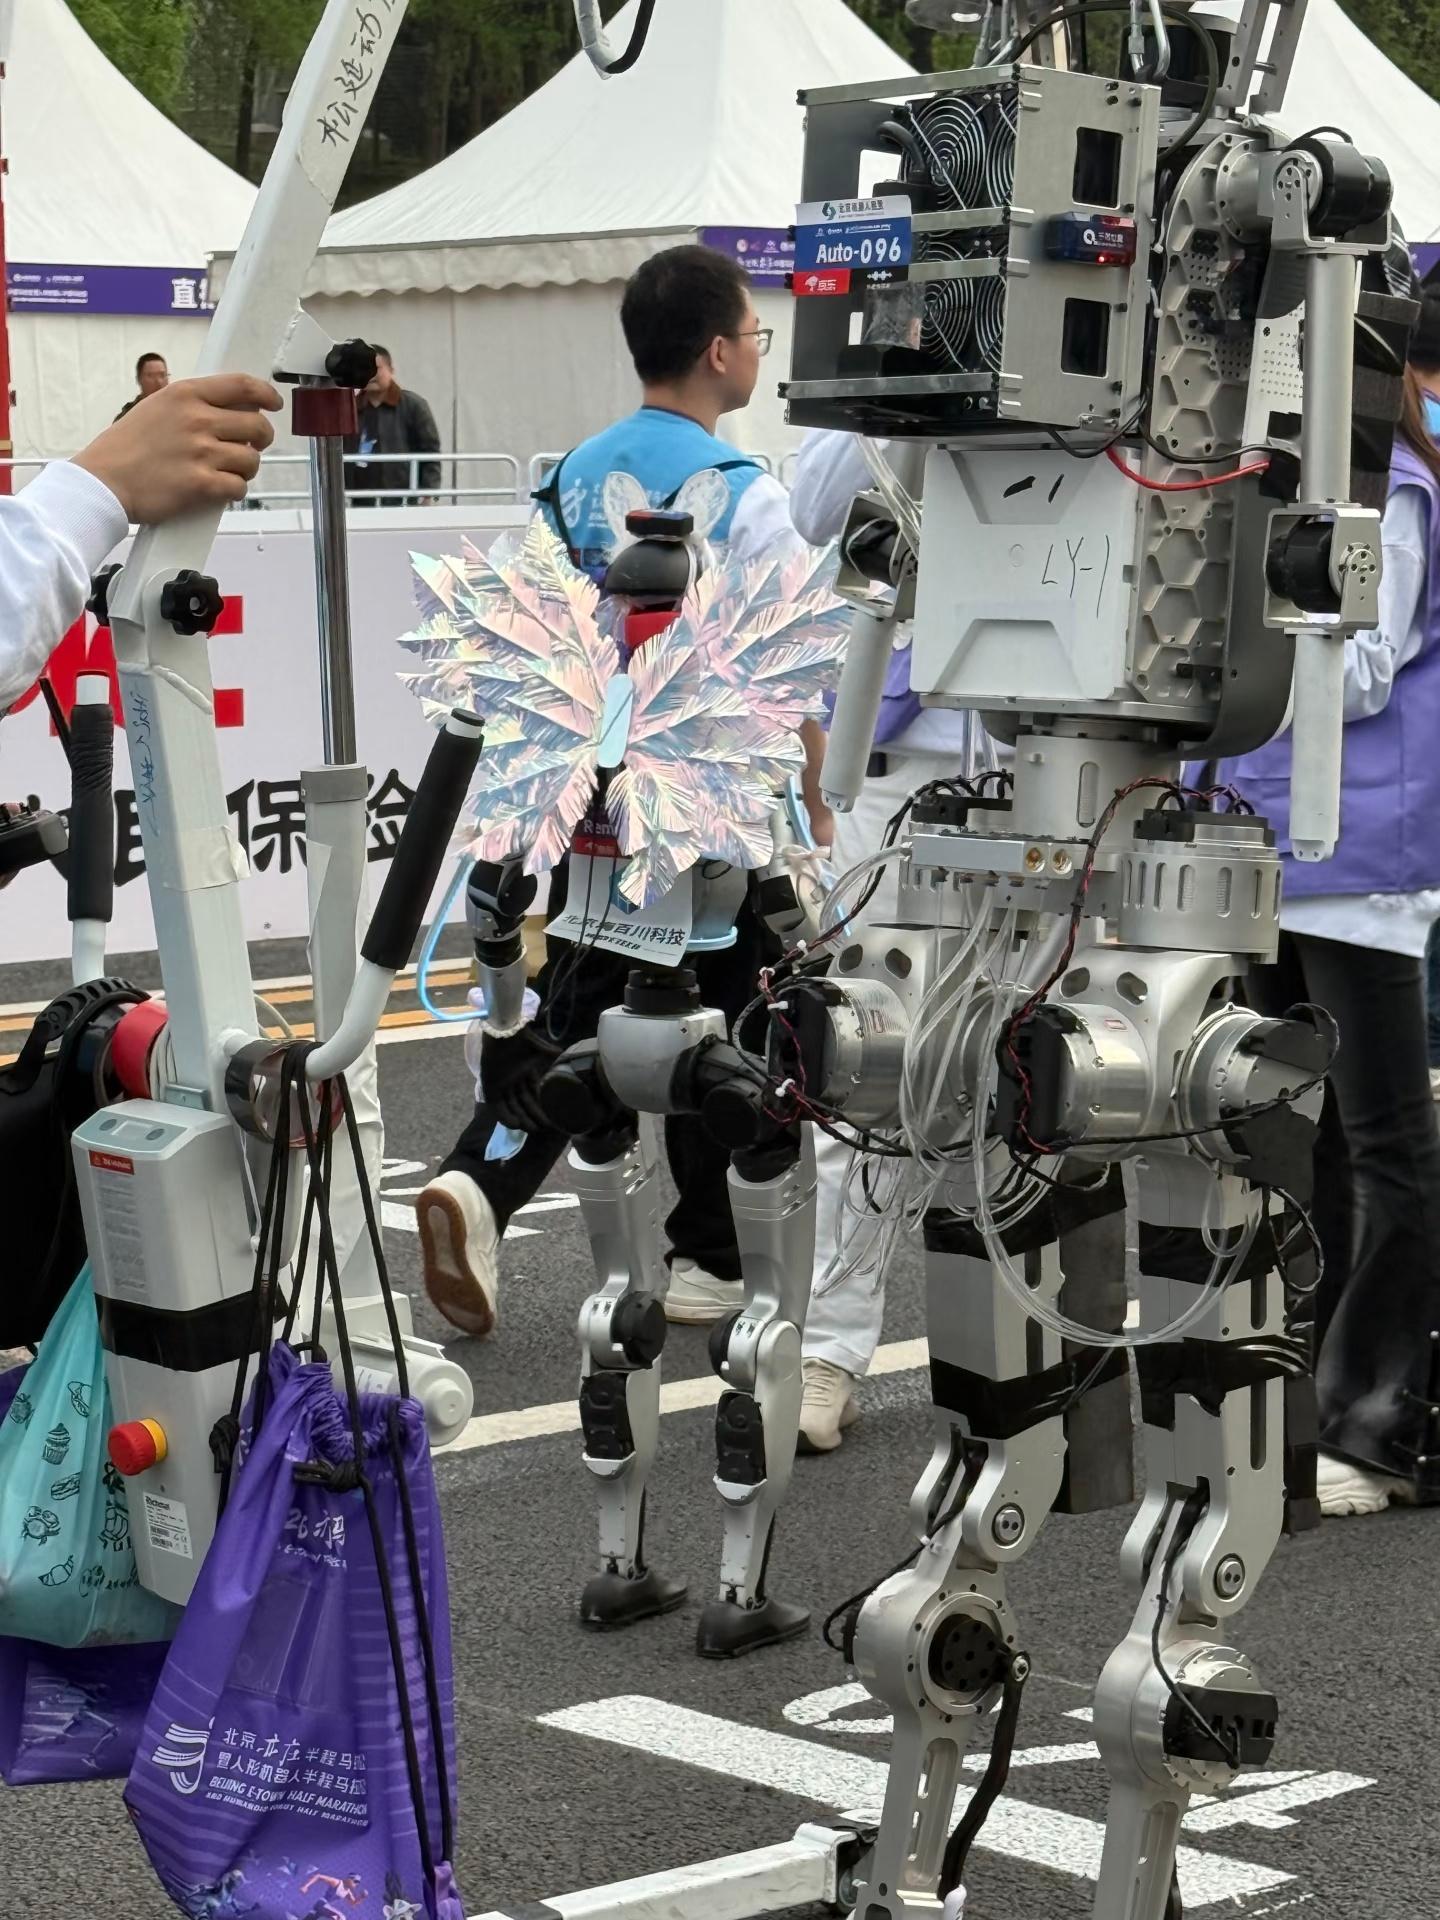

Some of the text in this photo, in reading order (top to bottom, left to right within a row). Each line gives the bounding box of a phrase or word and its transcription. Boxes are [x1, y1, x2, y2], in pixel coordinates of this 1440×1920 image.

[316, 0, 395, 147] 松延动
[815, 236, 901, 264] Auto-096
[216, 1751, 367, 1795] 暨人形机器人半程马拉
[209, 1776, 246, 1794] BEIJING
[287, 1790, 316, 1804] HALF
[316, 1796, 367, 1815] MARATHON
